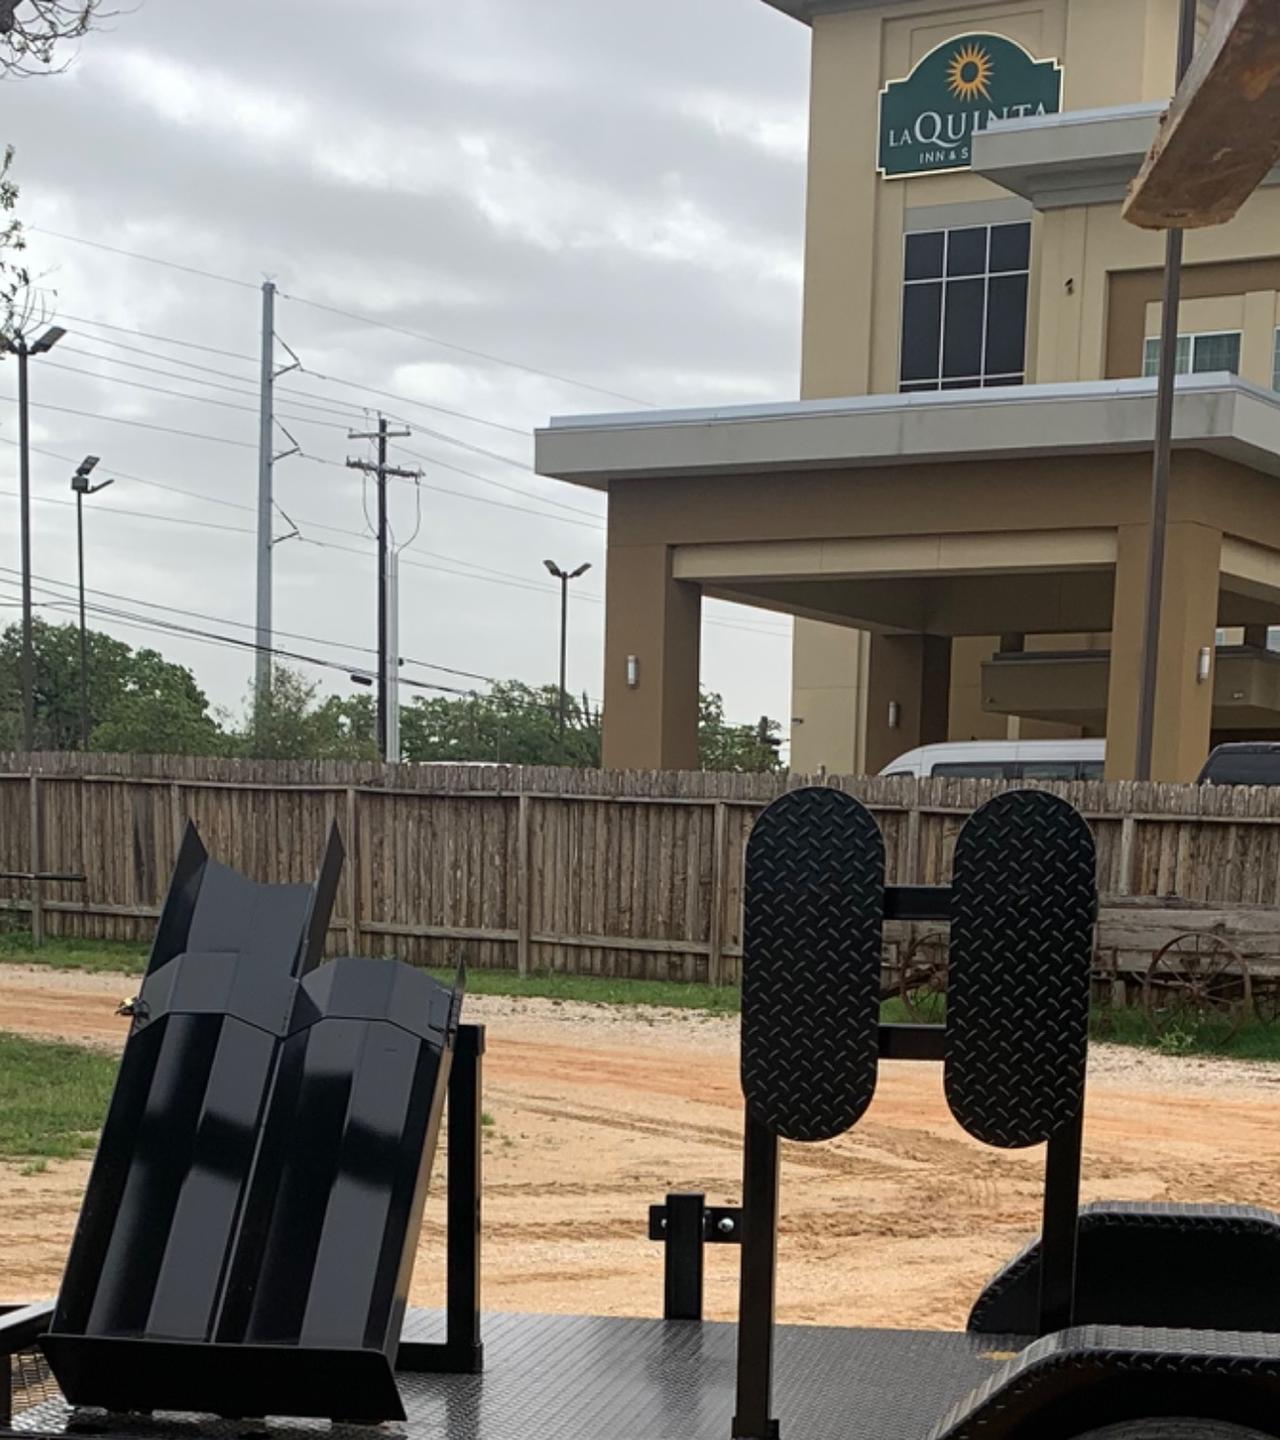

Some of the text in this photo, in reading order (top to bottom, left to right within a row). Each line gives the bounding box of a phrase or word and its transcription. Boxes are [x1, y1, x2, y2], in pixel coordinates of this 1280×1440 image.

[889, 128, 912, 147] LA
[920, 150, 945, 164] INN
[949, 150, 956, 160] &
